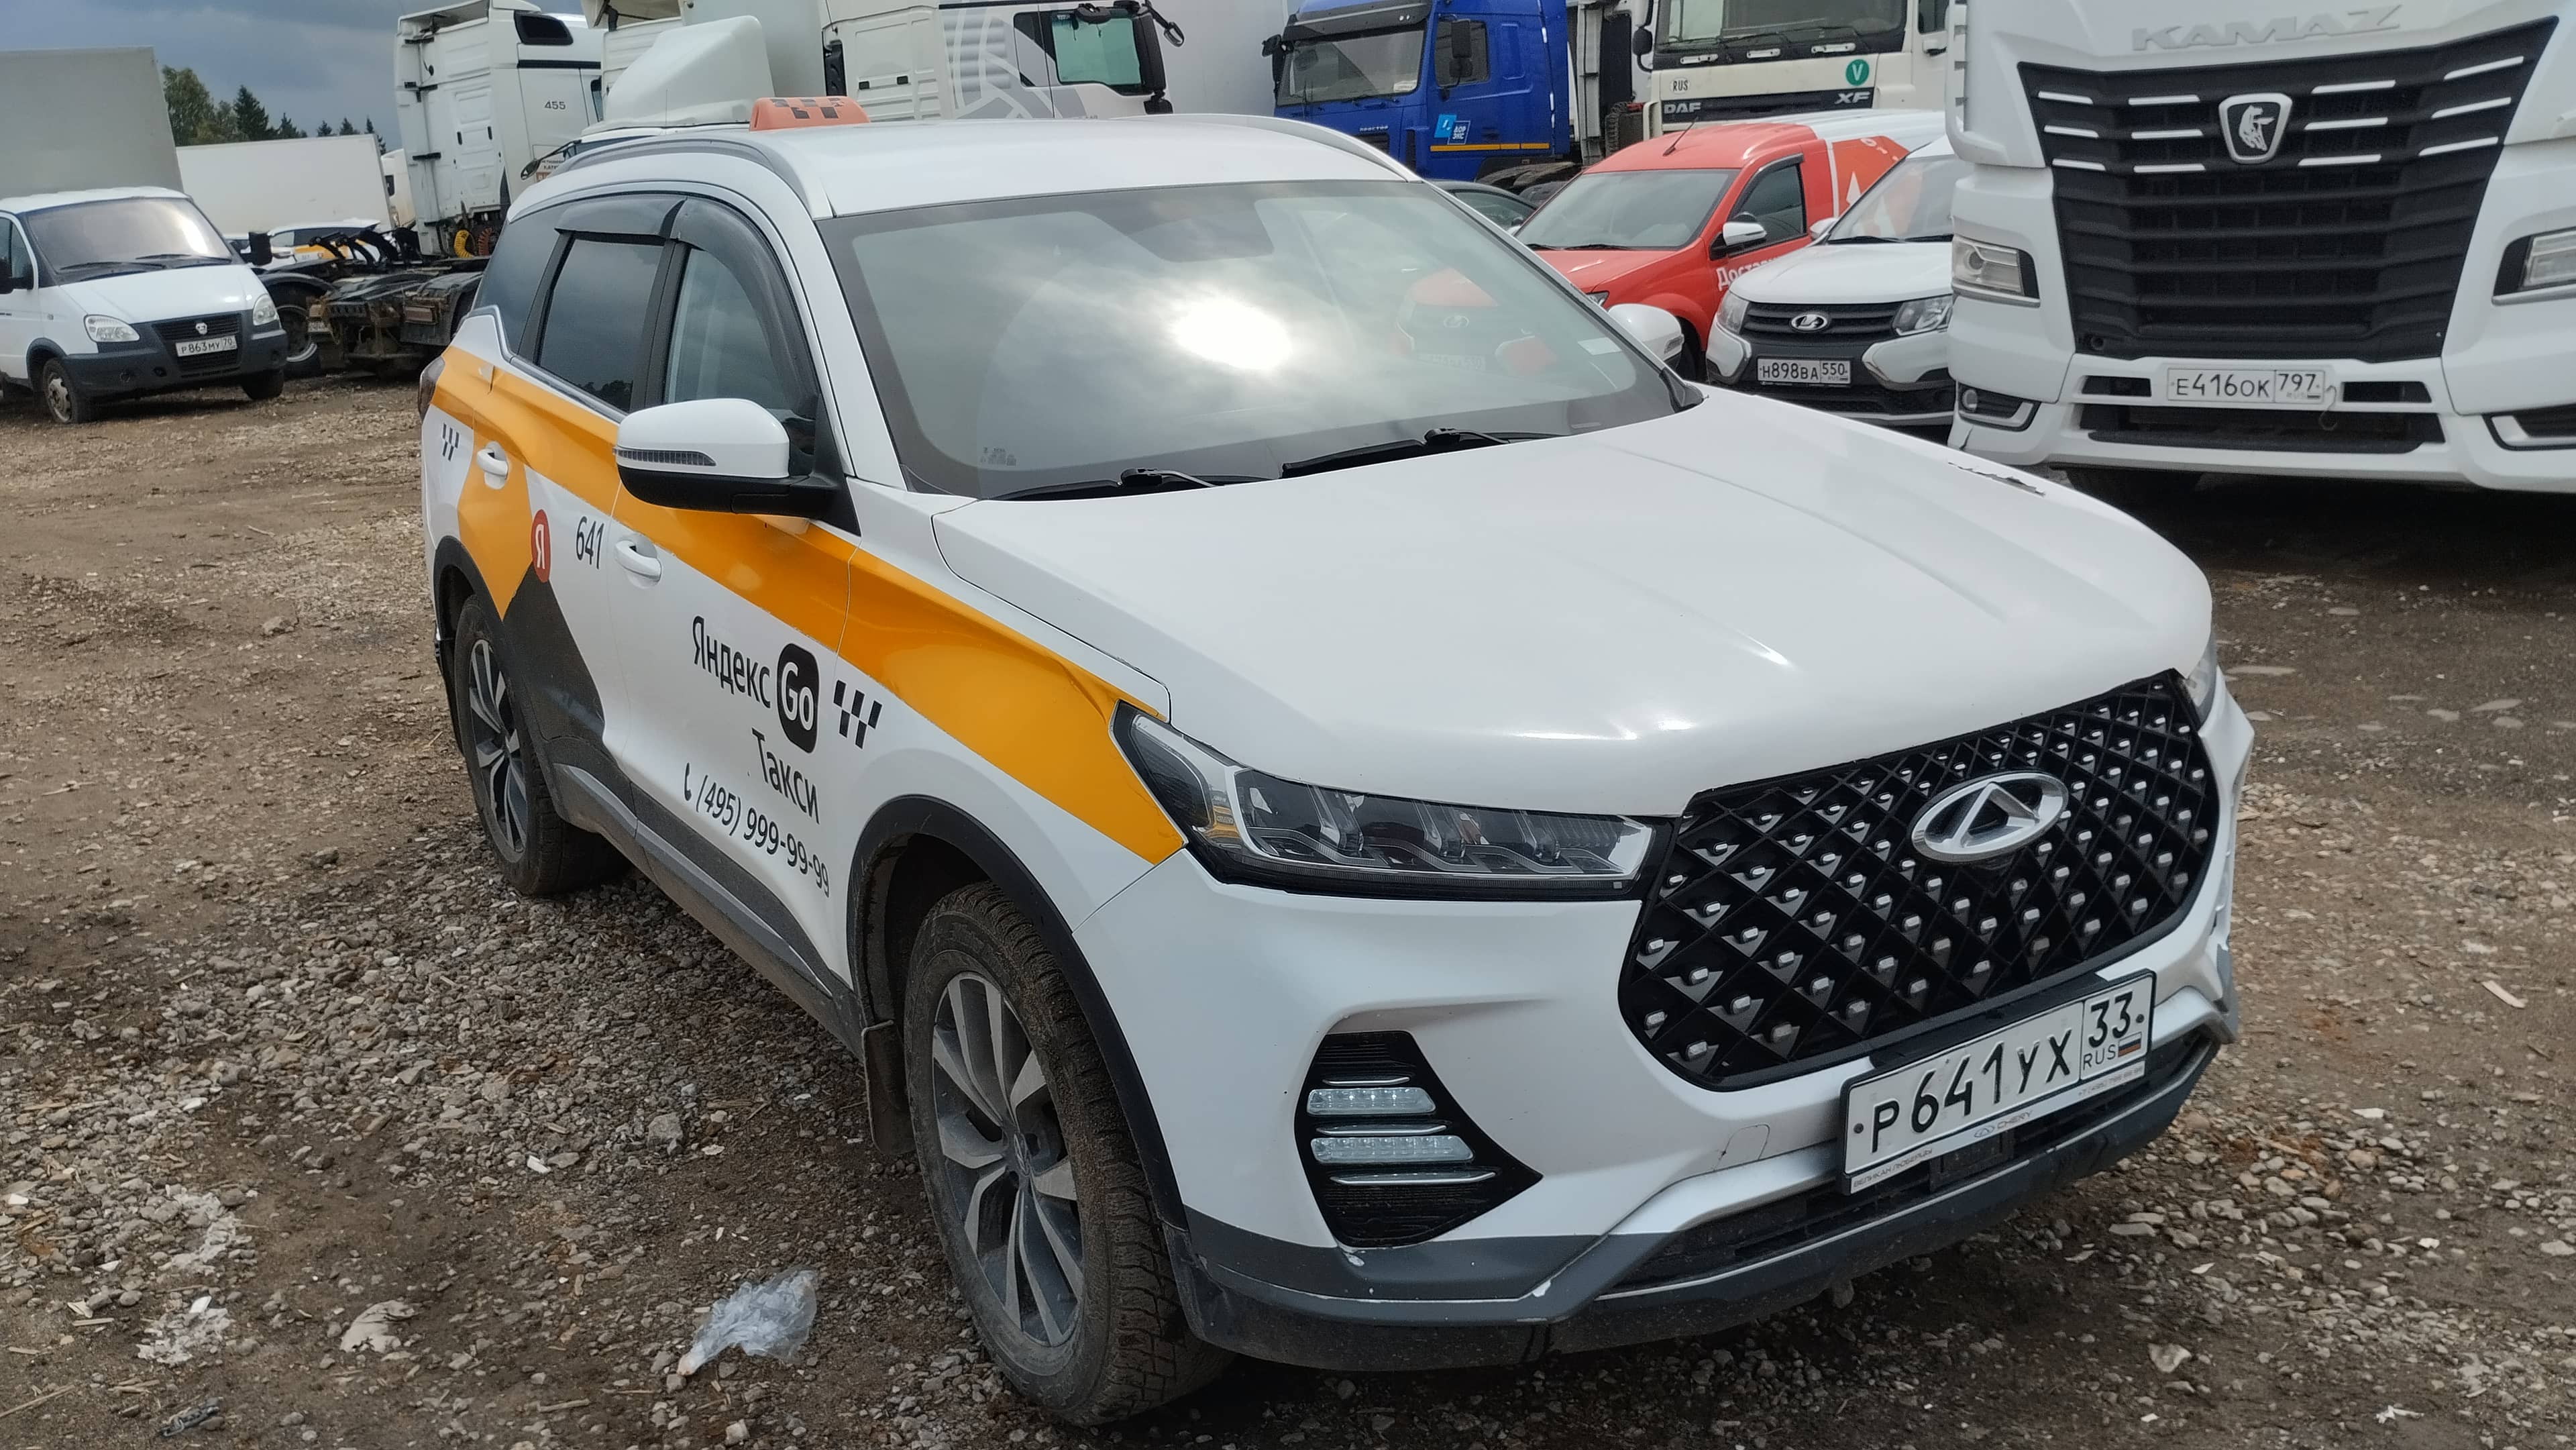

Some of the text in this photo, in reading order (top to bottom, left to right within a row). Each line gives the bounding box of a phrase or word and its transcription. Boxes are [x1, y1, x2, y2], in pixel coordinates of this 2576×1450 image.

[2132, 5, 2401, 50] KAMAZ
[1672, 80, 1688, 91] RUS
[1852, 63, 1864, 81] V
[544, 101, 566, 110] 455
[1664, 102, 1701, 114] DAF
[1835, 91, 1871, 104] XF
[1762, 362, 1845, 380] Н898ВА 550
[2176, 373, 2316, 397] Е416ОК 797
[535, 523, 545, 570] Я
[576, 516, 604, 570] 641
[692, 615, 812, 731] Яндекс Go
[751, 727, 820, 825] Такси
[696, 774, 830, 898] (495) 999-99-99
[2083, 1043, 2116, 1071] RUS
[1871, 991, 2134, 1153] Р641УХ 33
